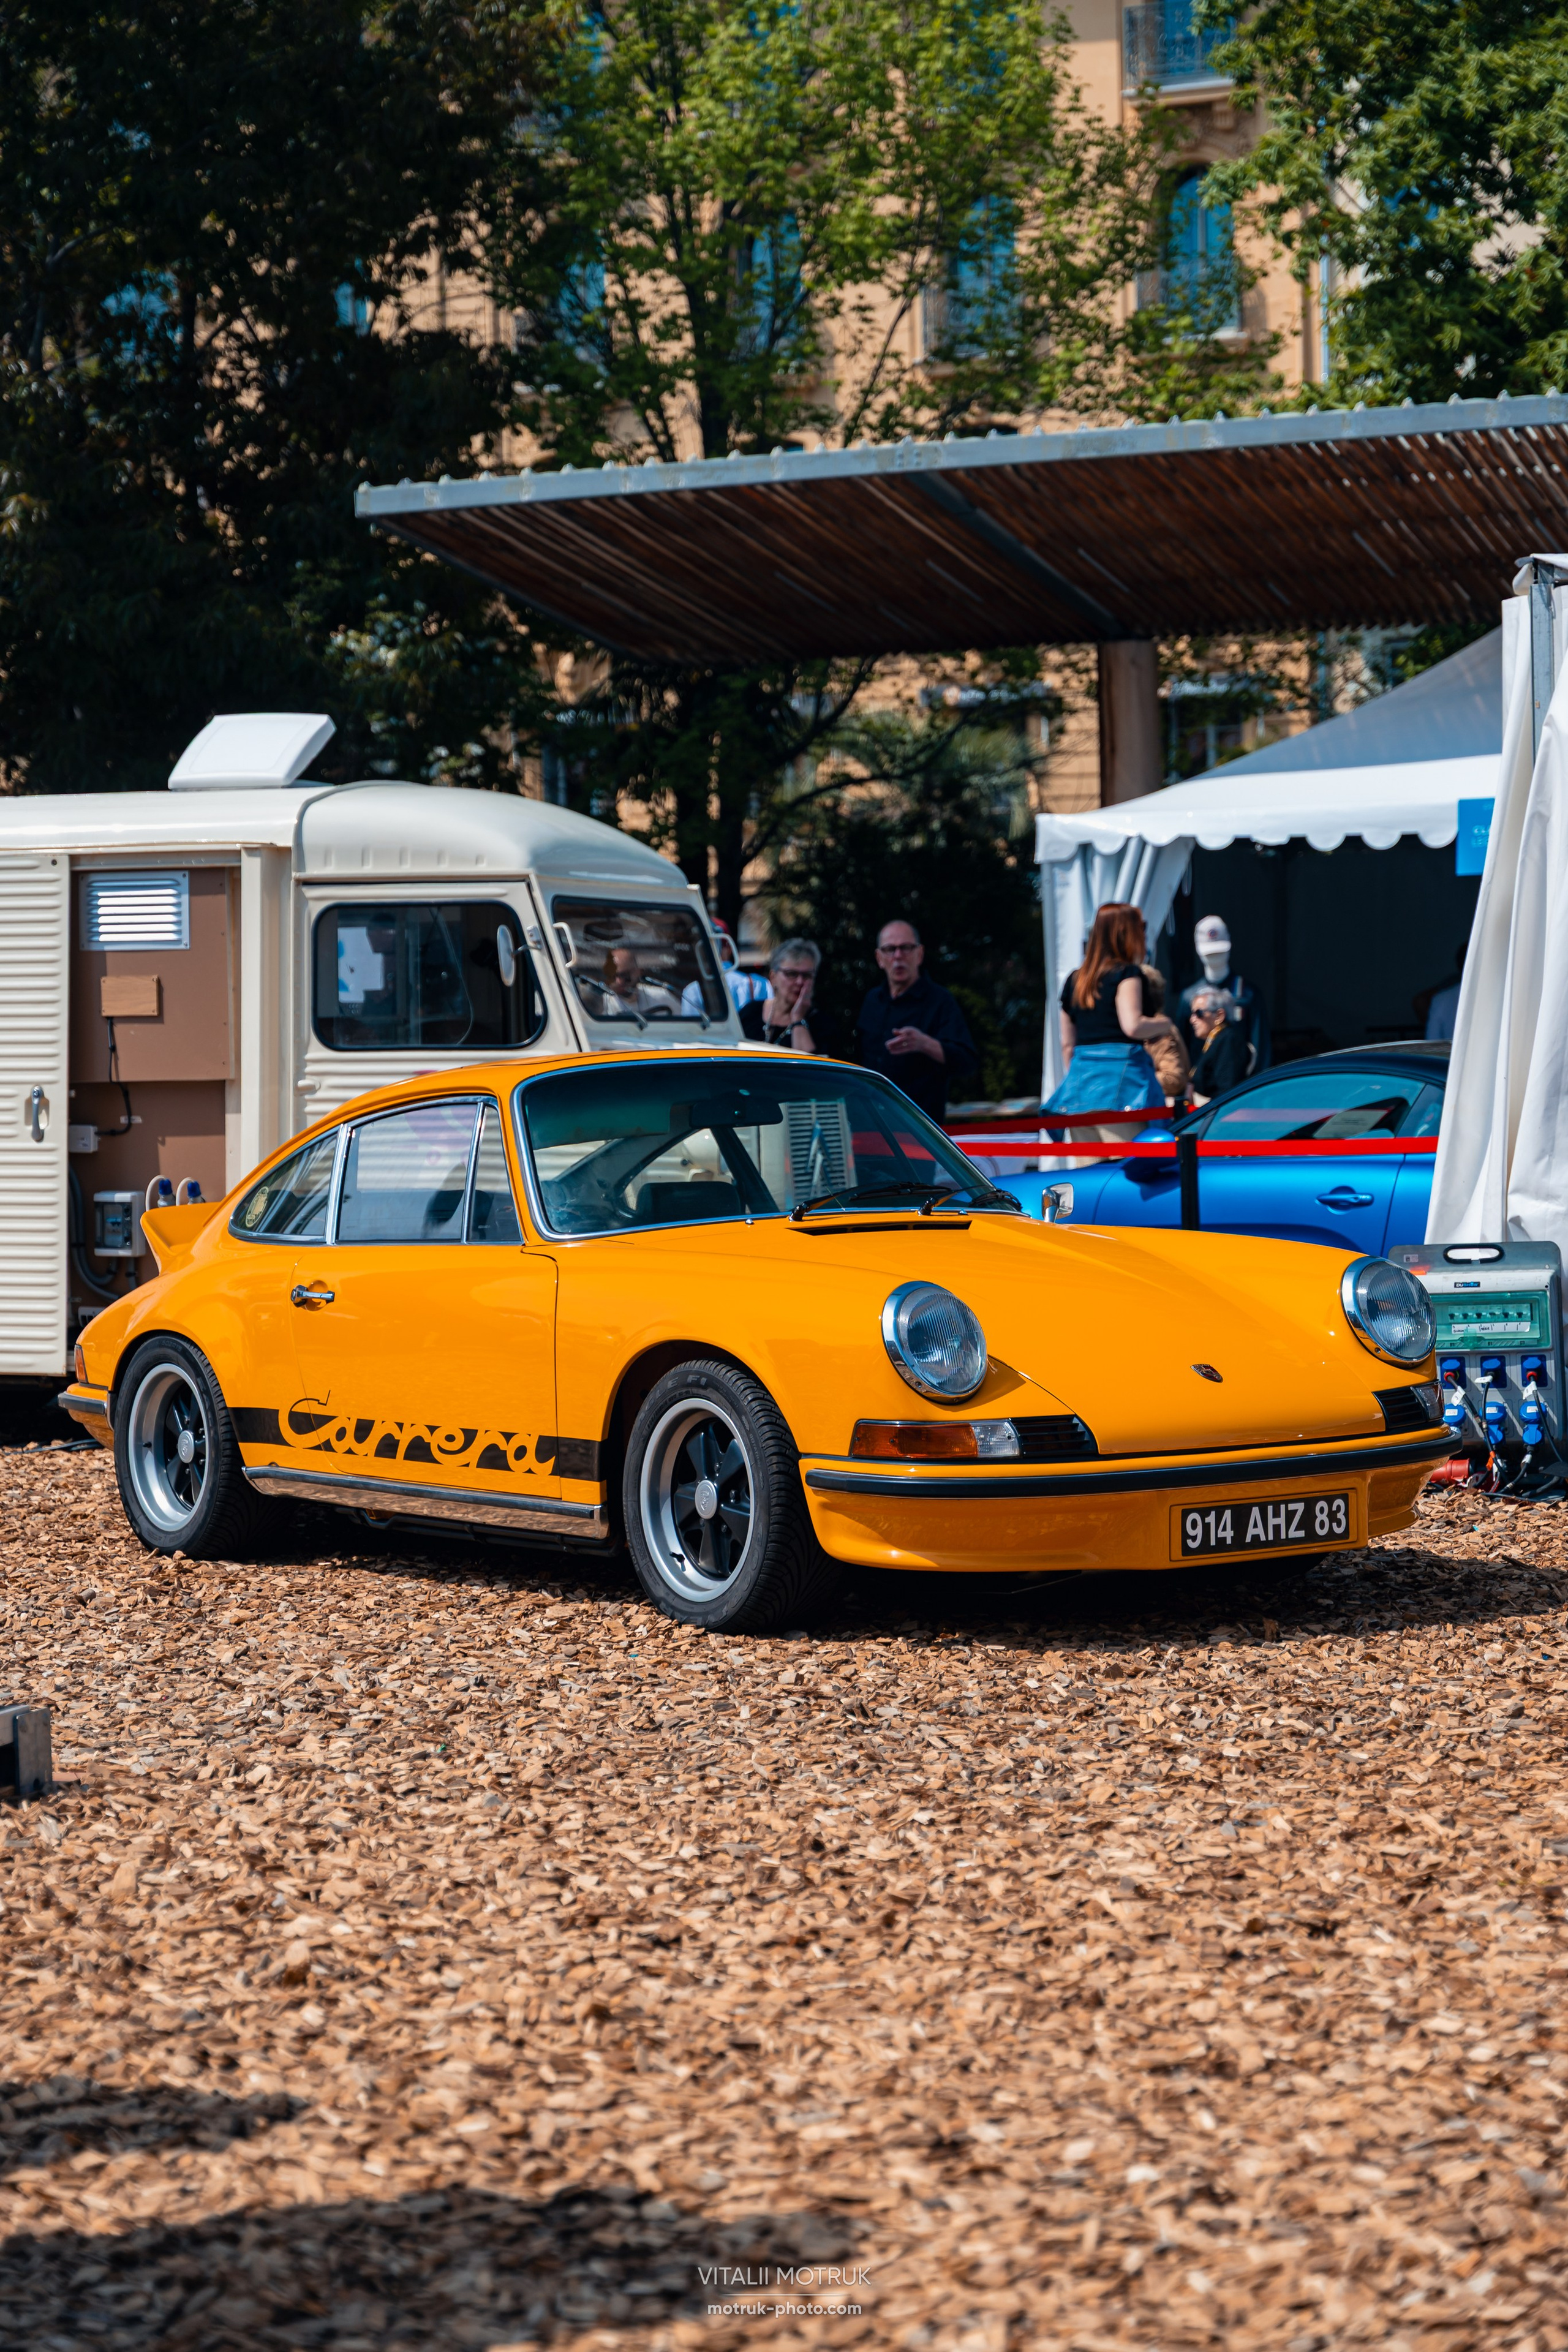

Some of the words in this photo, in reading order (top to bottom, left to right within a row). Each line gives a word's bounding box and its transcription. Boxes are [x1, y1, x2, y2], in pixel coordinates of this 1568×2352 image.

[686, 1374, 707, 1386] F1
[278, 1390, 556, 1476] Carrera
[748, 1433, 762, 1468] ROTATION
[1186, 1509, 1234, 1548] 914
[1245, 1502, 1305, 1543] AHZ
[1314, 1499, 1346, 1536] 83
[658, 1522, 764, 1629] GOODYEAR
